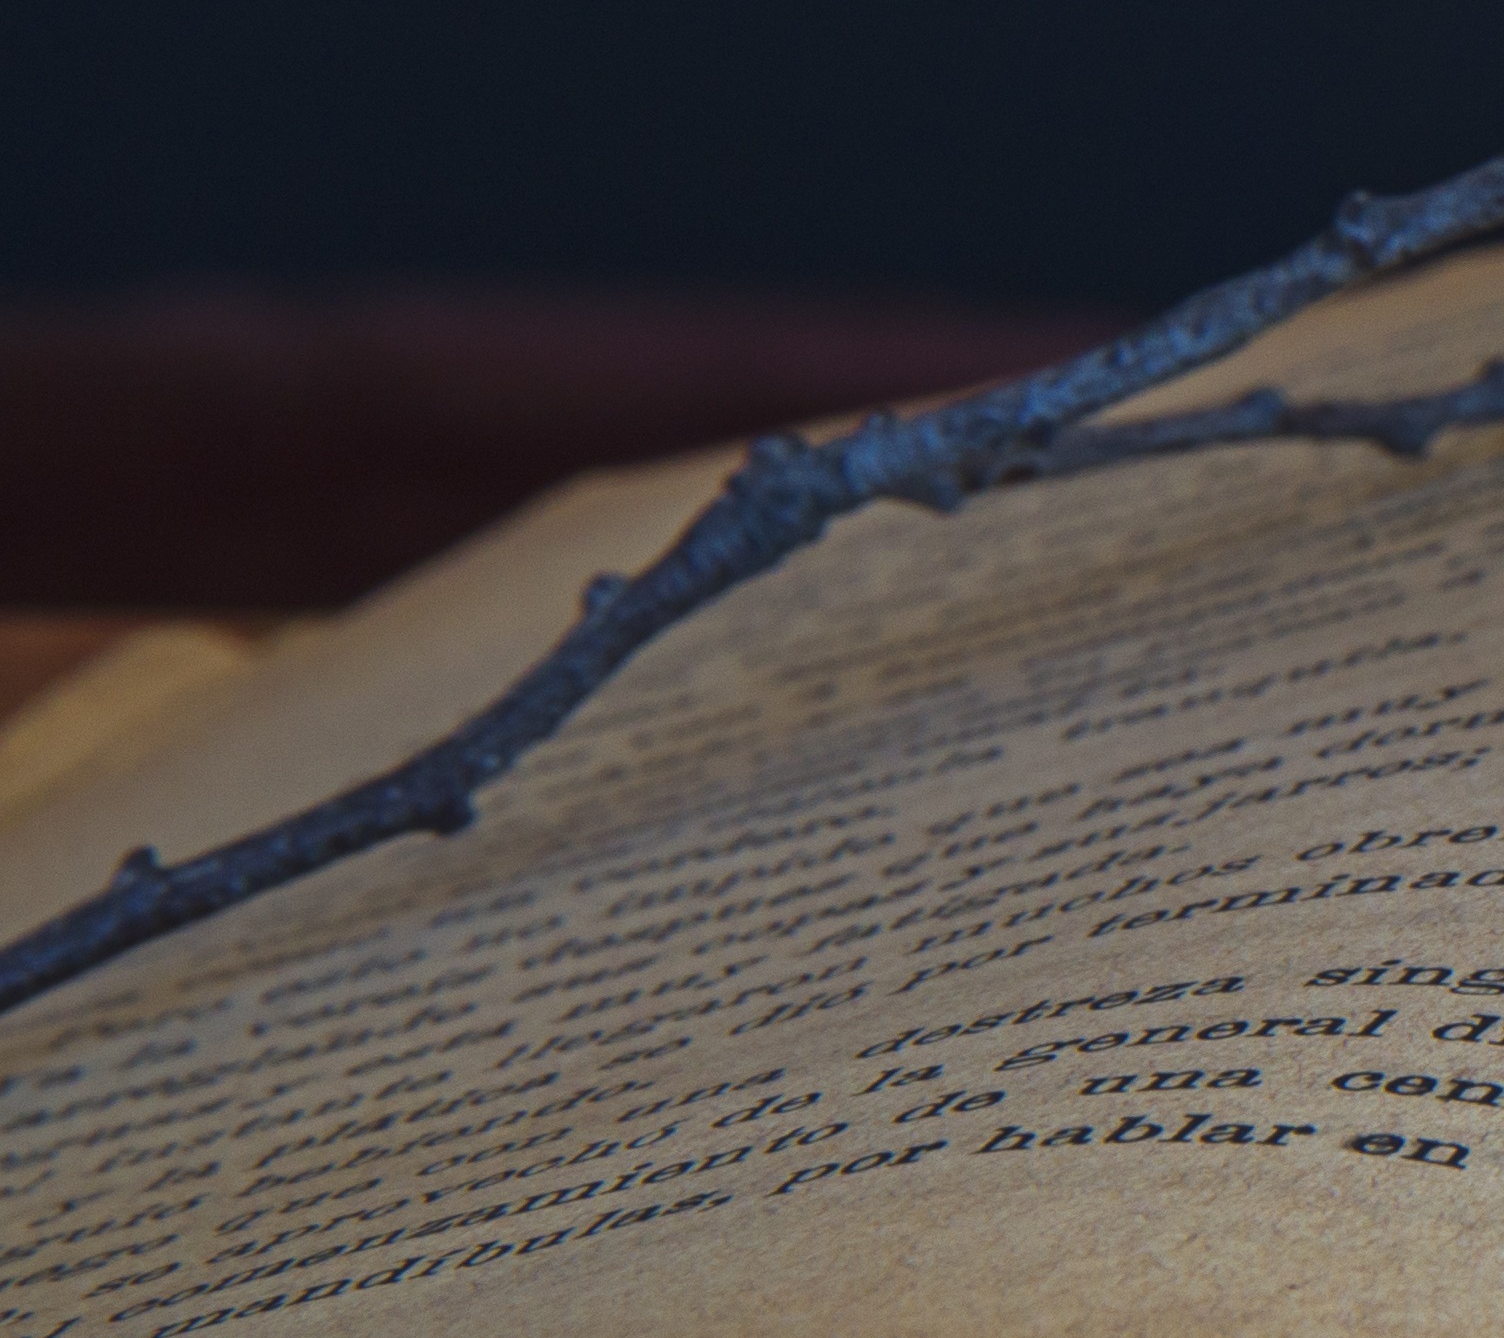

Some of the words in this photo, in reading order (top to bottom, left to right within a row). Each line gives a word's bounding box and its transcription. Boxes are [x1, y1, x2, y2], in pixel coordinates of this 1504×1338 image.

[495, 956, 868, 1070] llegaron
[912, 854, 1261, 954] muchos
[617, 1067, 785, 1123] una
[856, 975, 1245, 1059] destreza
[895, 935, 1054, 994] por
[109, 1121, 850, 1323] comenzamiento
[894, 1090, 1006, 1124] de
[1081, 1068, 1261, 1096] una
[206, 1120, 680, 1265] aprovechó
[713, 1091, 822, 1129] de
[863, 1064, 943, 1094] la
[996, 1009, 1398, 1072] general
[772, 1139, 948, 1195] por
[978, 1113, 1317, 1154] hablar
[1344, 1133, 1470, 1170] en
